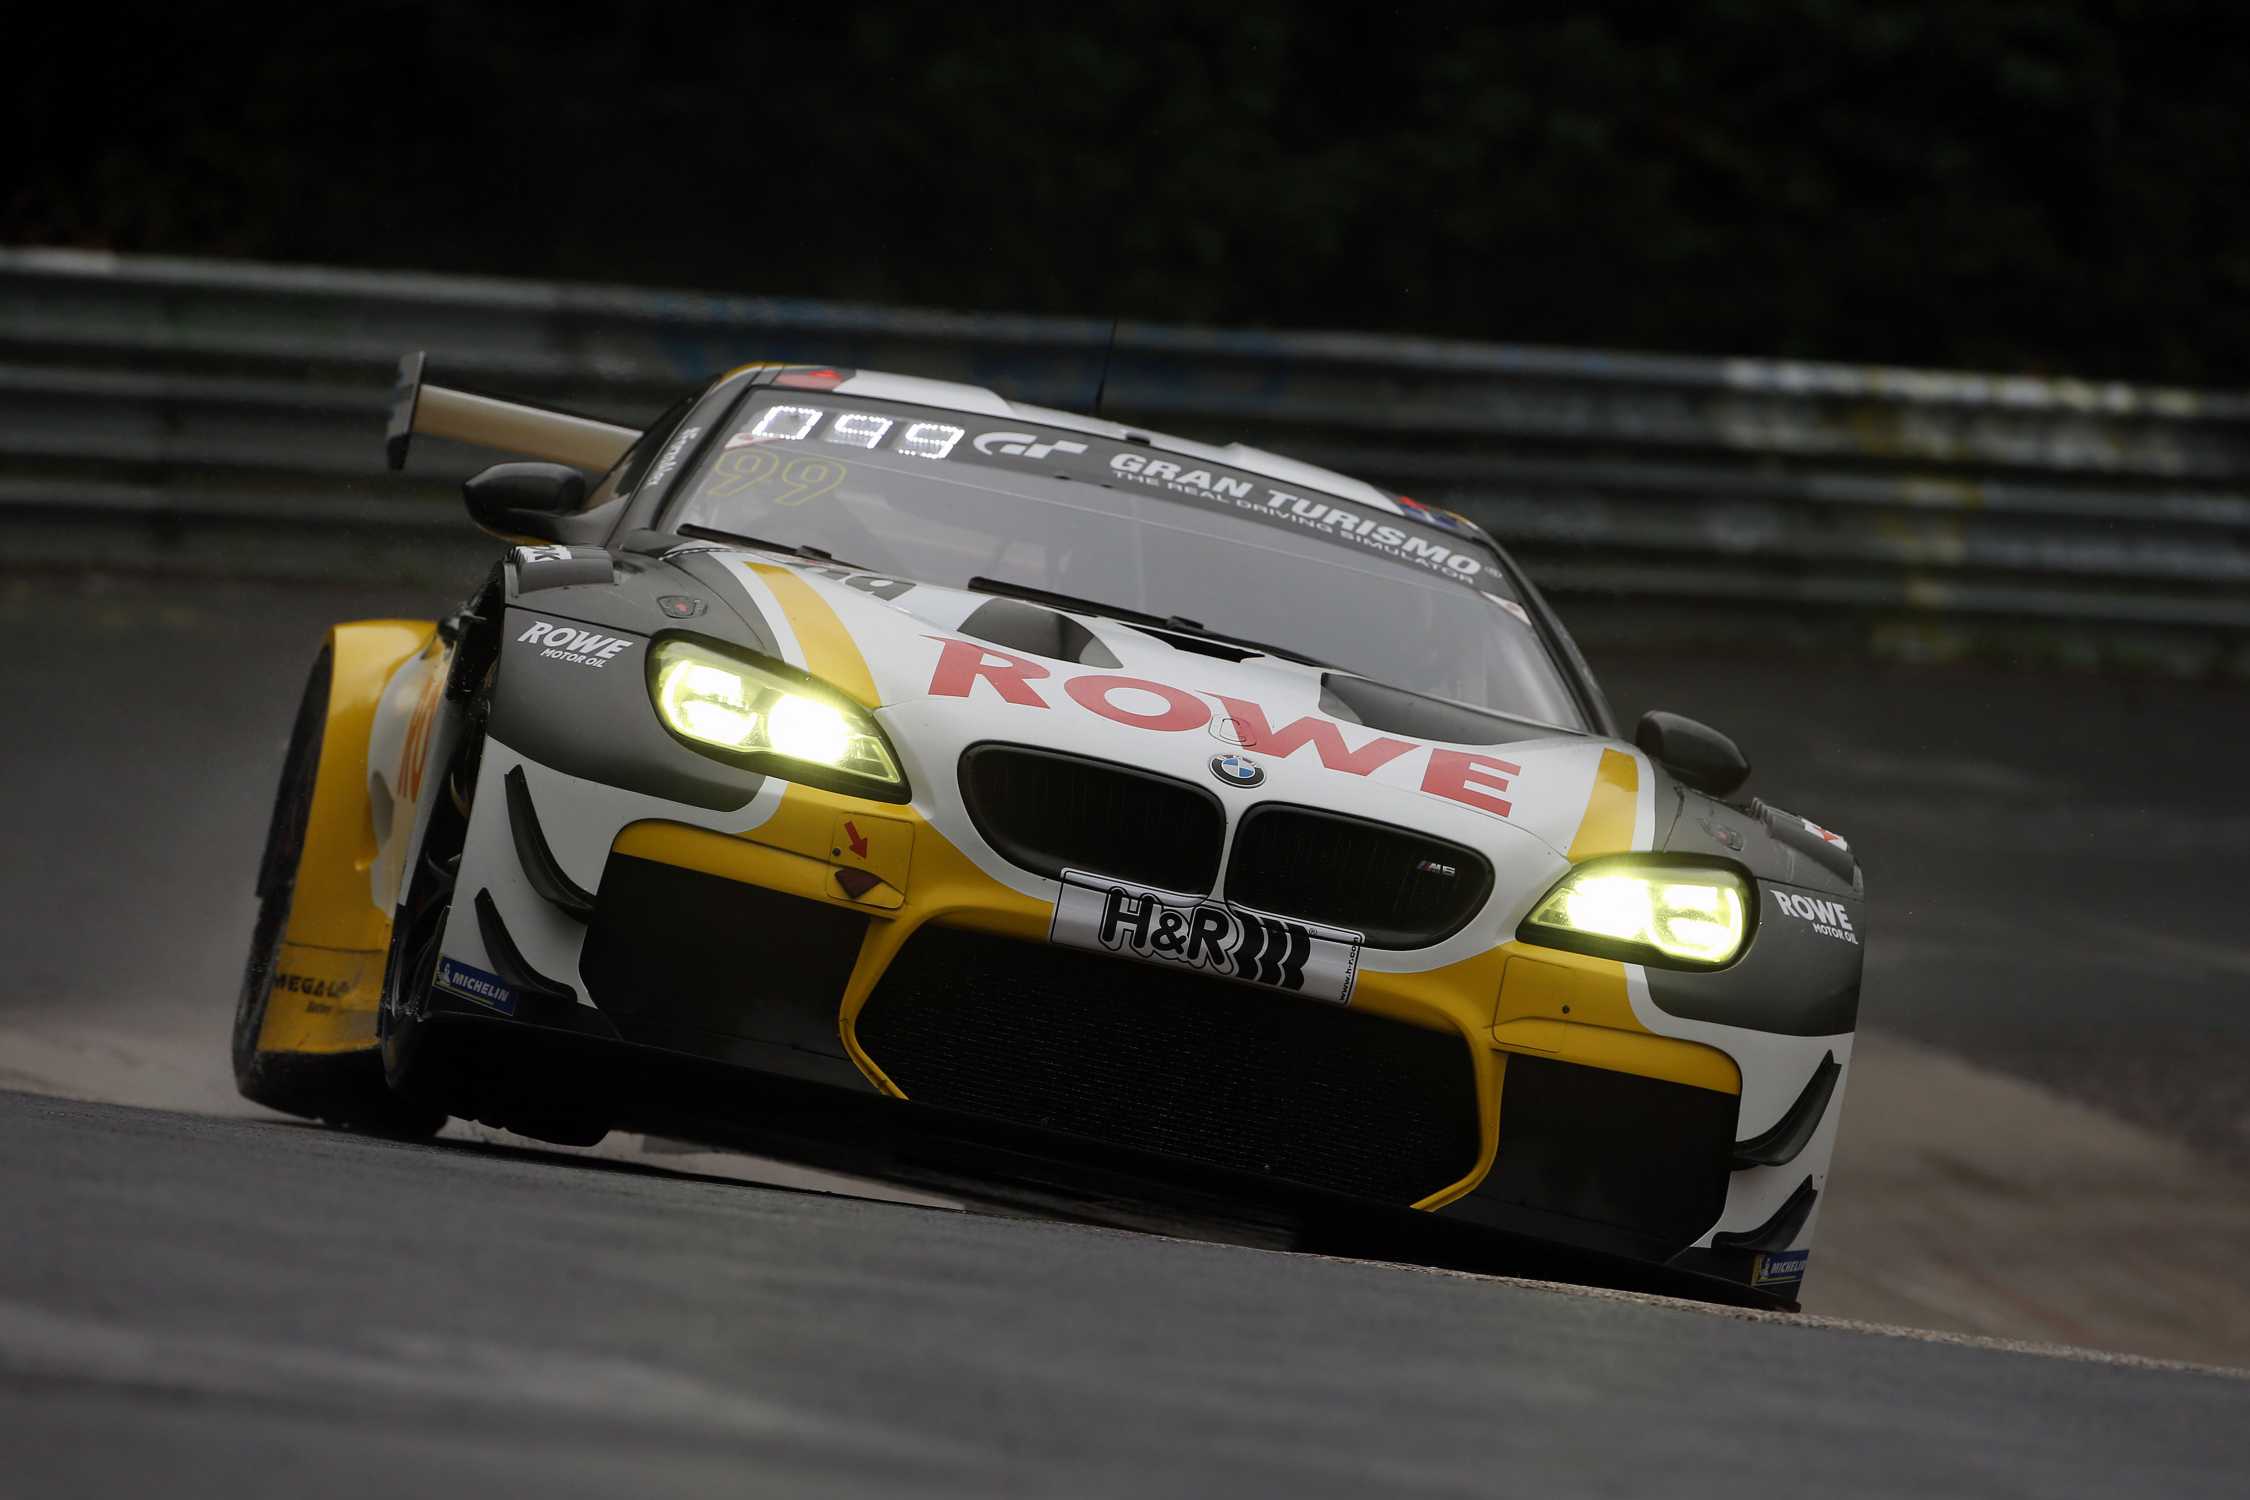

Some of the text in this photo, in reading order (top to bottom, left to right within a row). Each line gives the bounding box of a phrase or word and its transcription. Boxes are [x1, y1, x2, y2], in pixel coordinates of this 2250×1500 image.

[752, 404, 966, 460] 099
[704, 446, 847, 506] 99
[1110, 453, 1482, 575] GRAN TURISMO
[1112, 470, 1475, 585] THE REAL DRIVING SIMULATOR
[517, 621, 633, 659] ROWE
[540, 648, 607, 668] MOTOR OIL
[920, 634, 1522, 818] ROWE
[1768, 889, 1854, 931] ROWE
[1812, 922, 1846, 941] MOTOR
[452, 971, 510, 1003] MICHELIN
